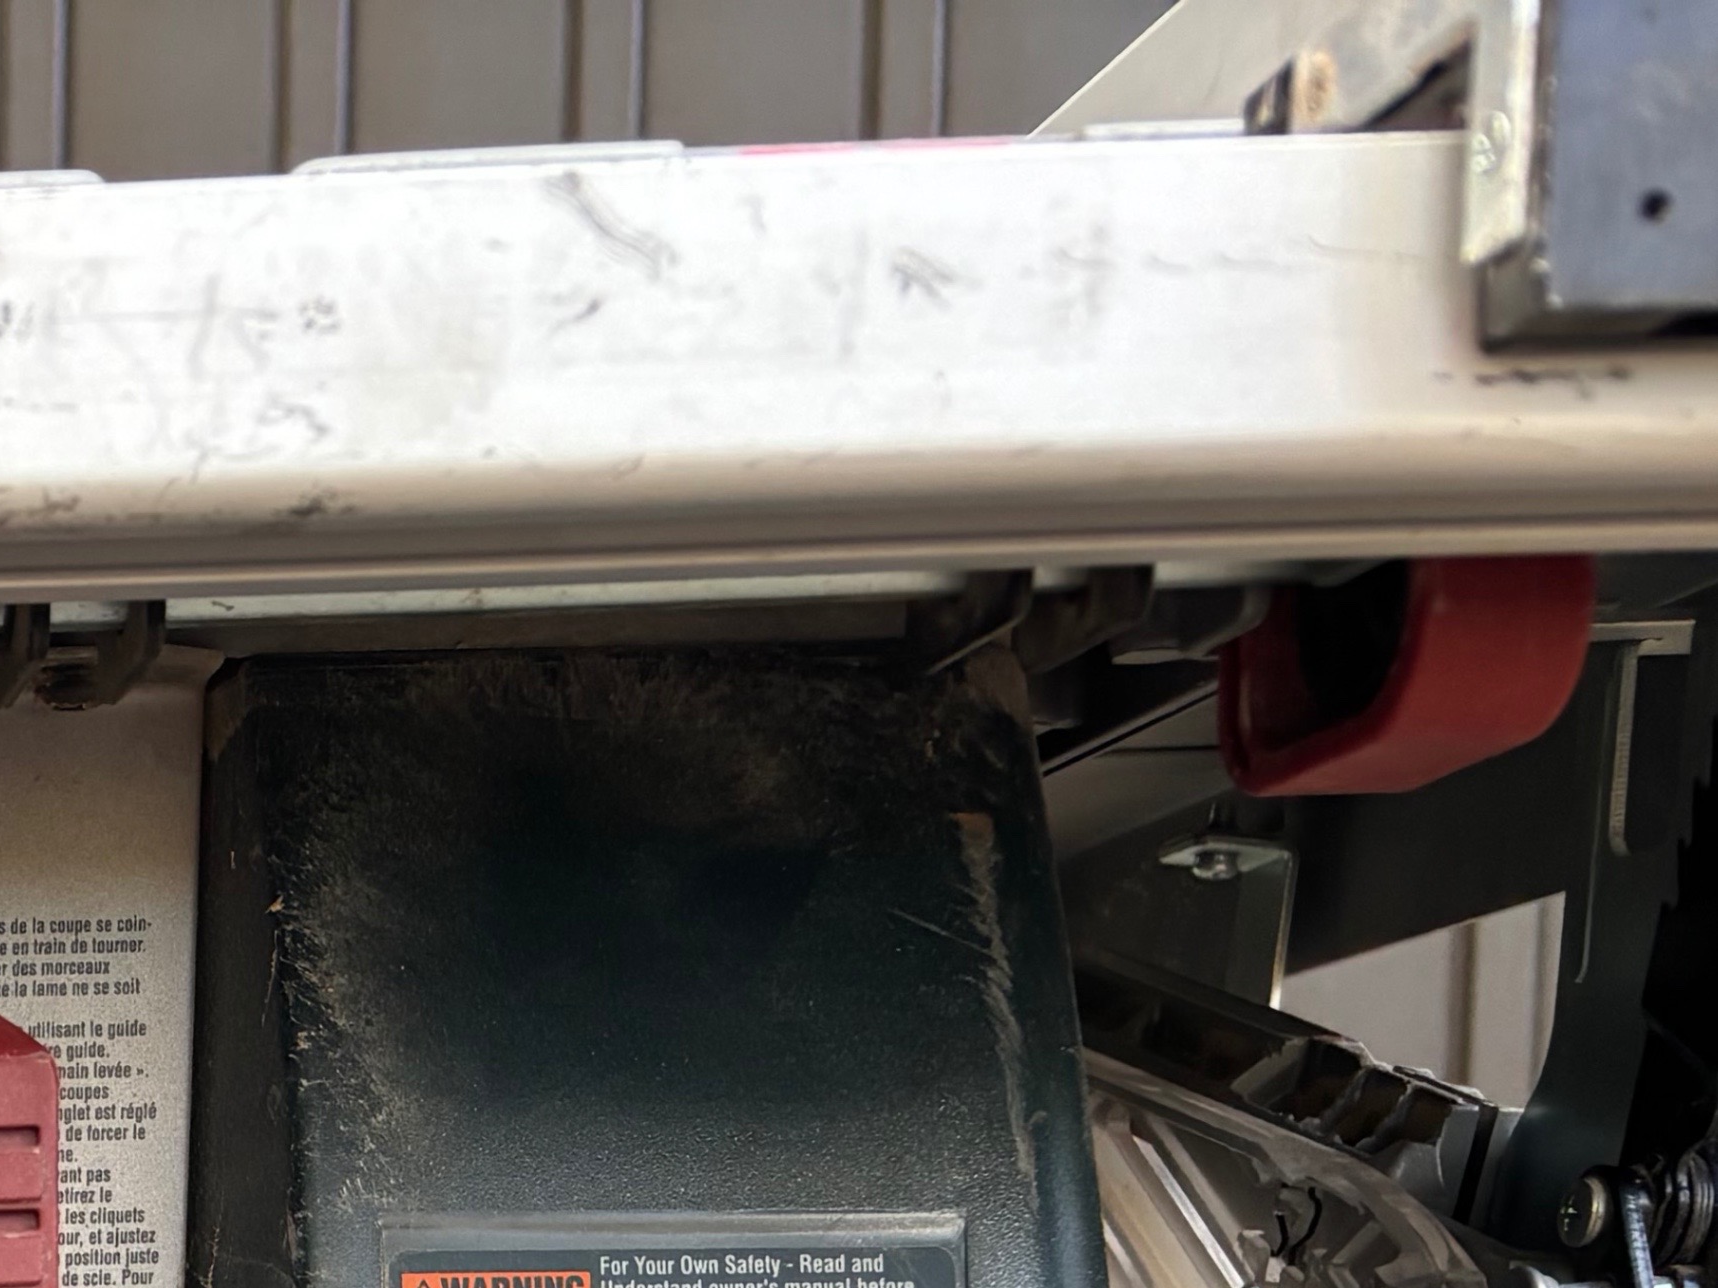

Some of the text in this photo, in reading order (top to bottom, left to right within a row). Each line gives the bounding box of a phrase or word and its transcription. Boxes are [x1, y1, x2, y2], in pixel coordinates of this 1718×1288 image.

[600, 1256, 629, 1276] For
[634, 1256, 674, 1276] Your
[680, 1255, 719, 1275] Own
[724, 1254, 781, 1278] Safety
[799, 1254, 846, 1274] Read
[851, 1254, 884, 1273] and
